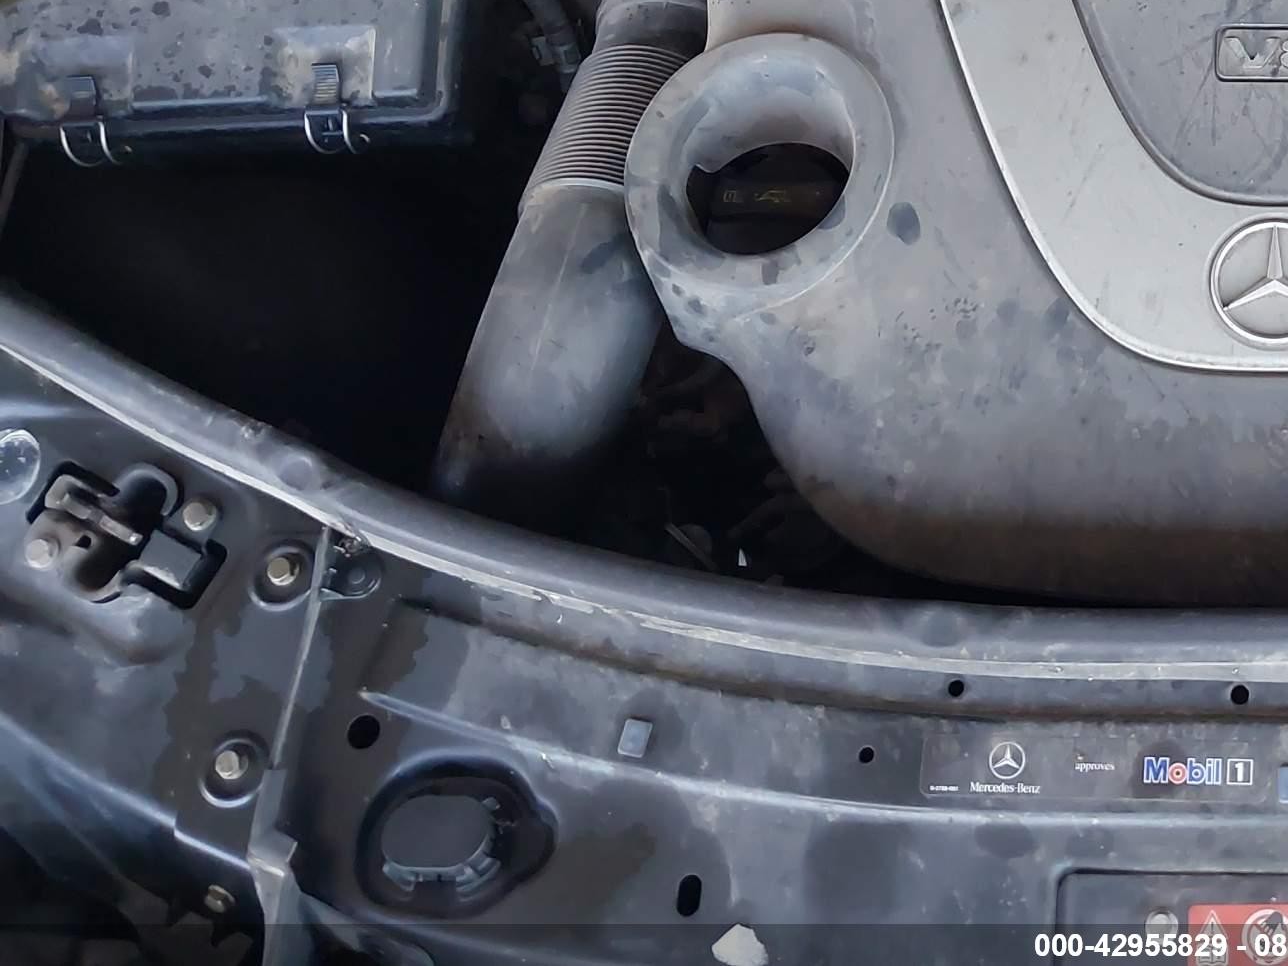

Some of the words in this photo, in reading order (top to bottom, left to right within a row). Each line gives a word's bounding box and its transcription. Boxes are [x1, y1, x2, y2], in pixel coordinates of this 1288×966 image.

[1074, 762, 1115, 772] approves
[1143, 756, 1222, 785] Mobil
[969, 782, 1041, 794] Mercedes-Benz
